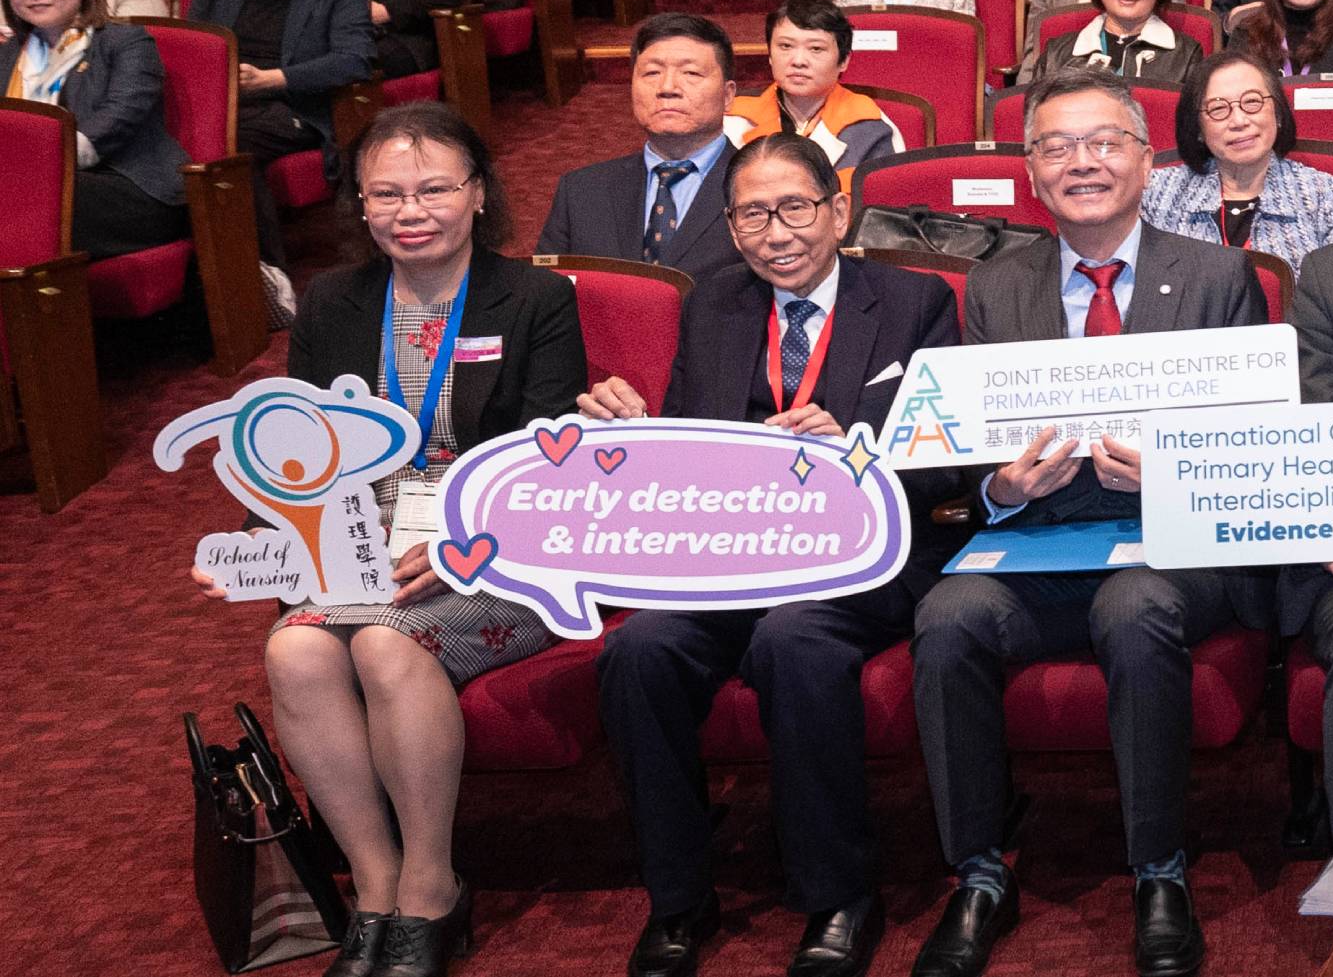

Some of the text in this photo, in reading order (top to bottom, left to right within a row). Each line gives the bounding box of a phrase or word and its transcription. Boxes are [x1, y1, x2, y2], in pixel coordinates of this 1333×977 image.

[984, 352, 1286, 388] JOINT RESEARCH CENTRE FOR
[984, 379, 1219, 410] PRIMARY HEALTH CARE
[985, 419, 1141, 447] 基層健康聯合研究
[1157, 422, 1320, 449] International
[1178, 460, 1274, 482] Primary
[507, 480, 826, 519] Early detection
[341, 494, 386, 592] 護理學院
[542, 523, 840, 555] & intervention
[1216, 521, 1333, 543] Evidence
[208, 541, 291, 566] School of
[226, 569, 300, 590] Nursing
